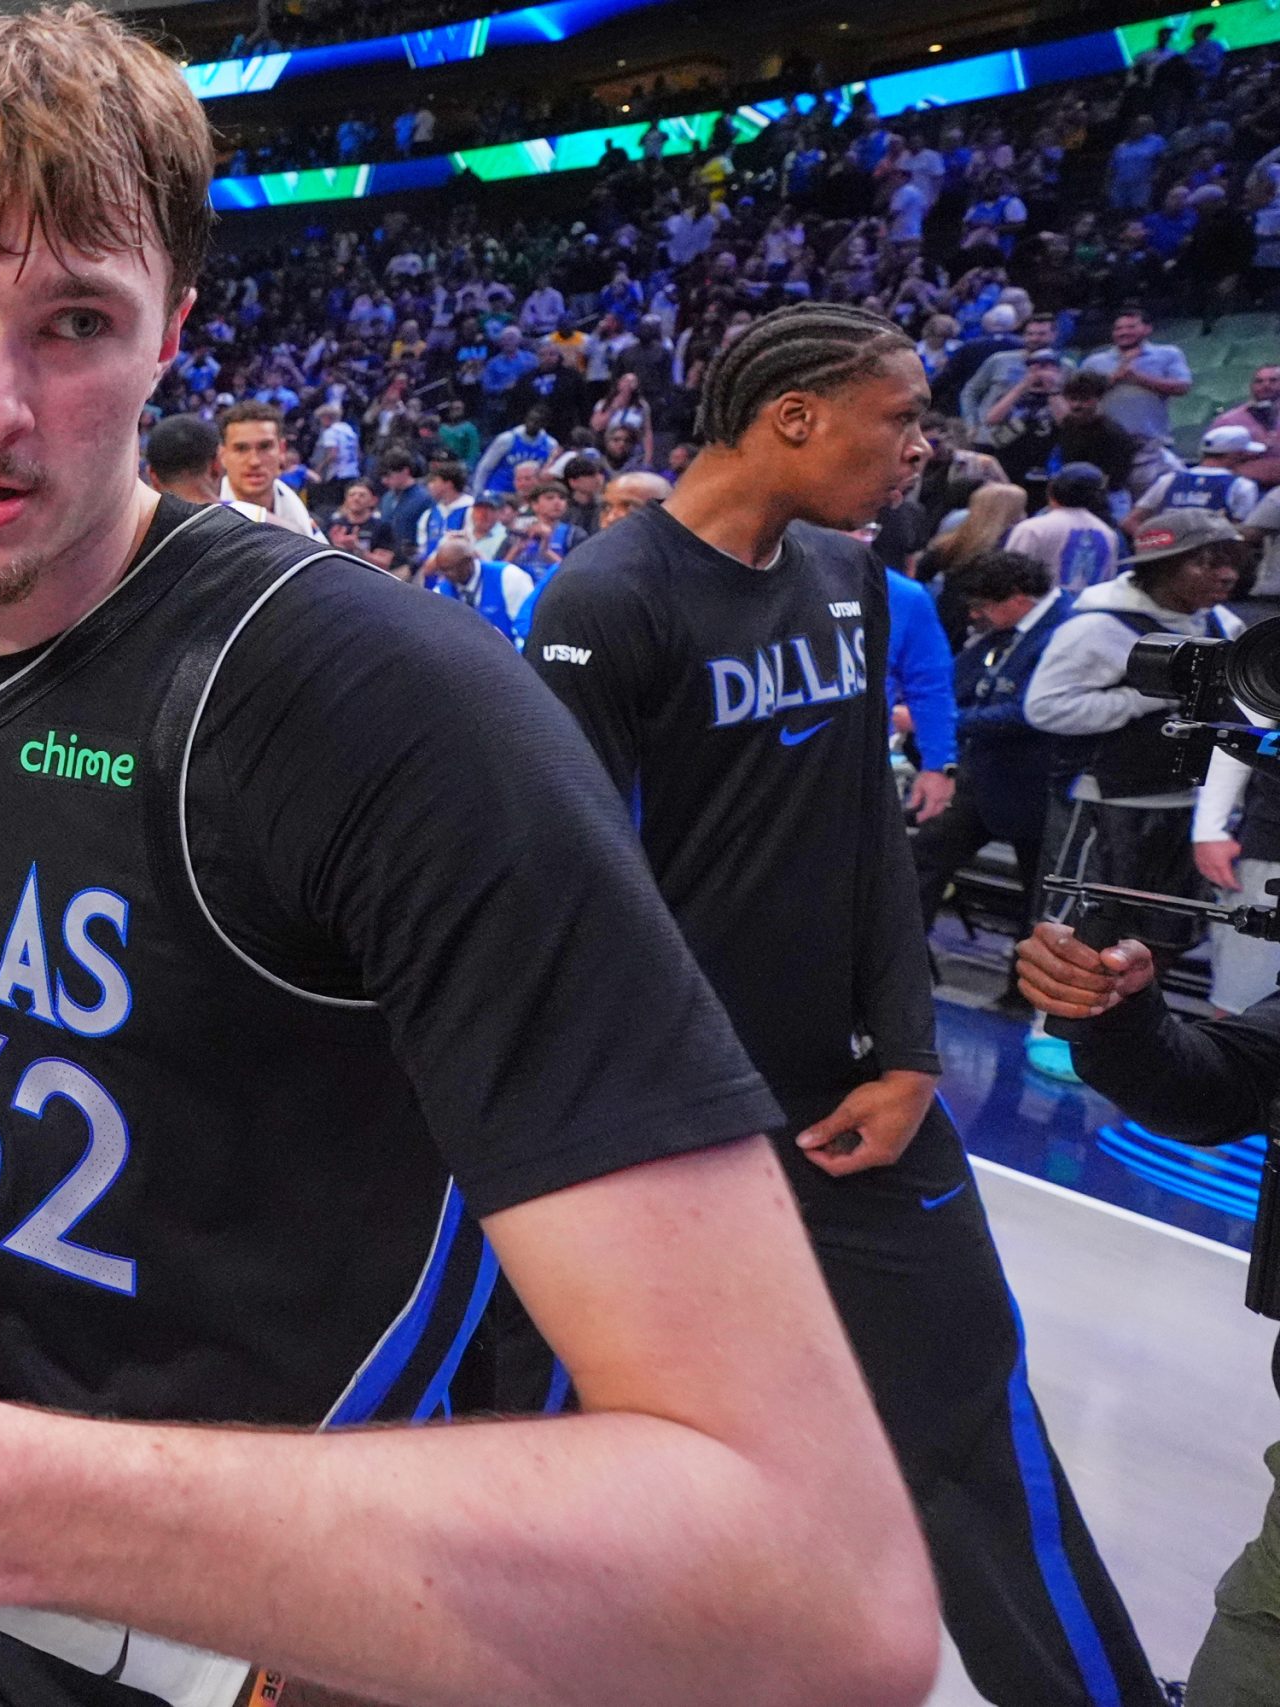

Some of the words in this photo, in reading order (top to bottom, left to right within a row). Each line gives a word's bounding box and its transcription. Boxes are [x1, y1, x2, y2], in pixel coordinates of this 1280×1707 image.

[828, 601, 862, 618] UTSW
[706, 624, 868, 728] DALLAS
[20, 730, 134, 787] chime
